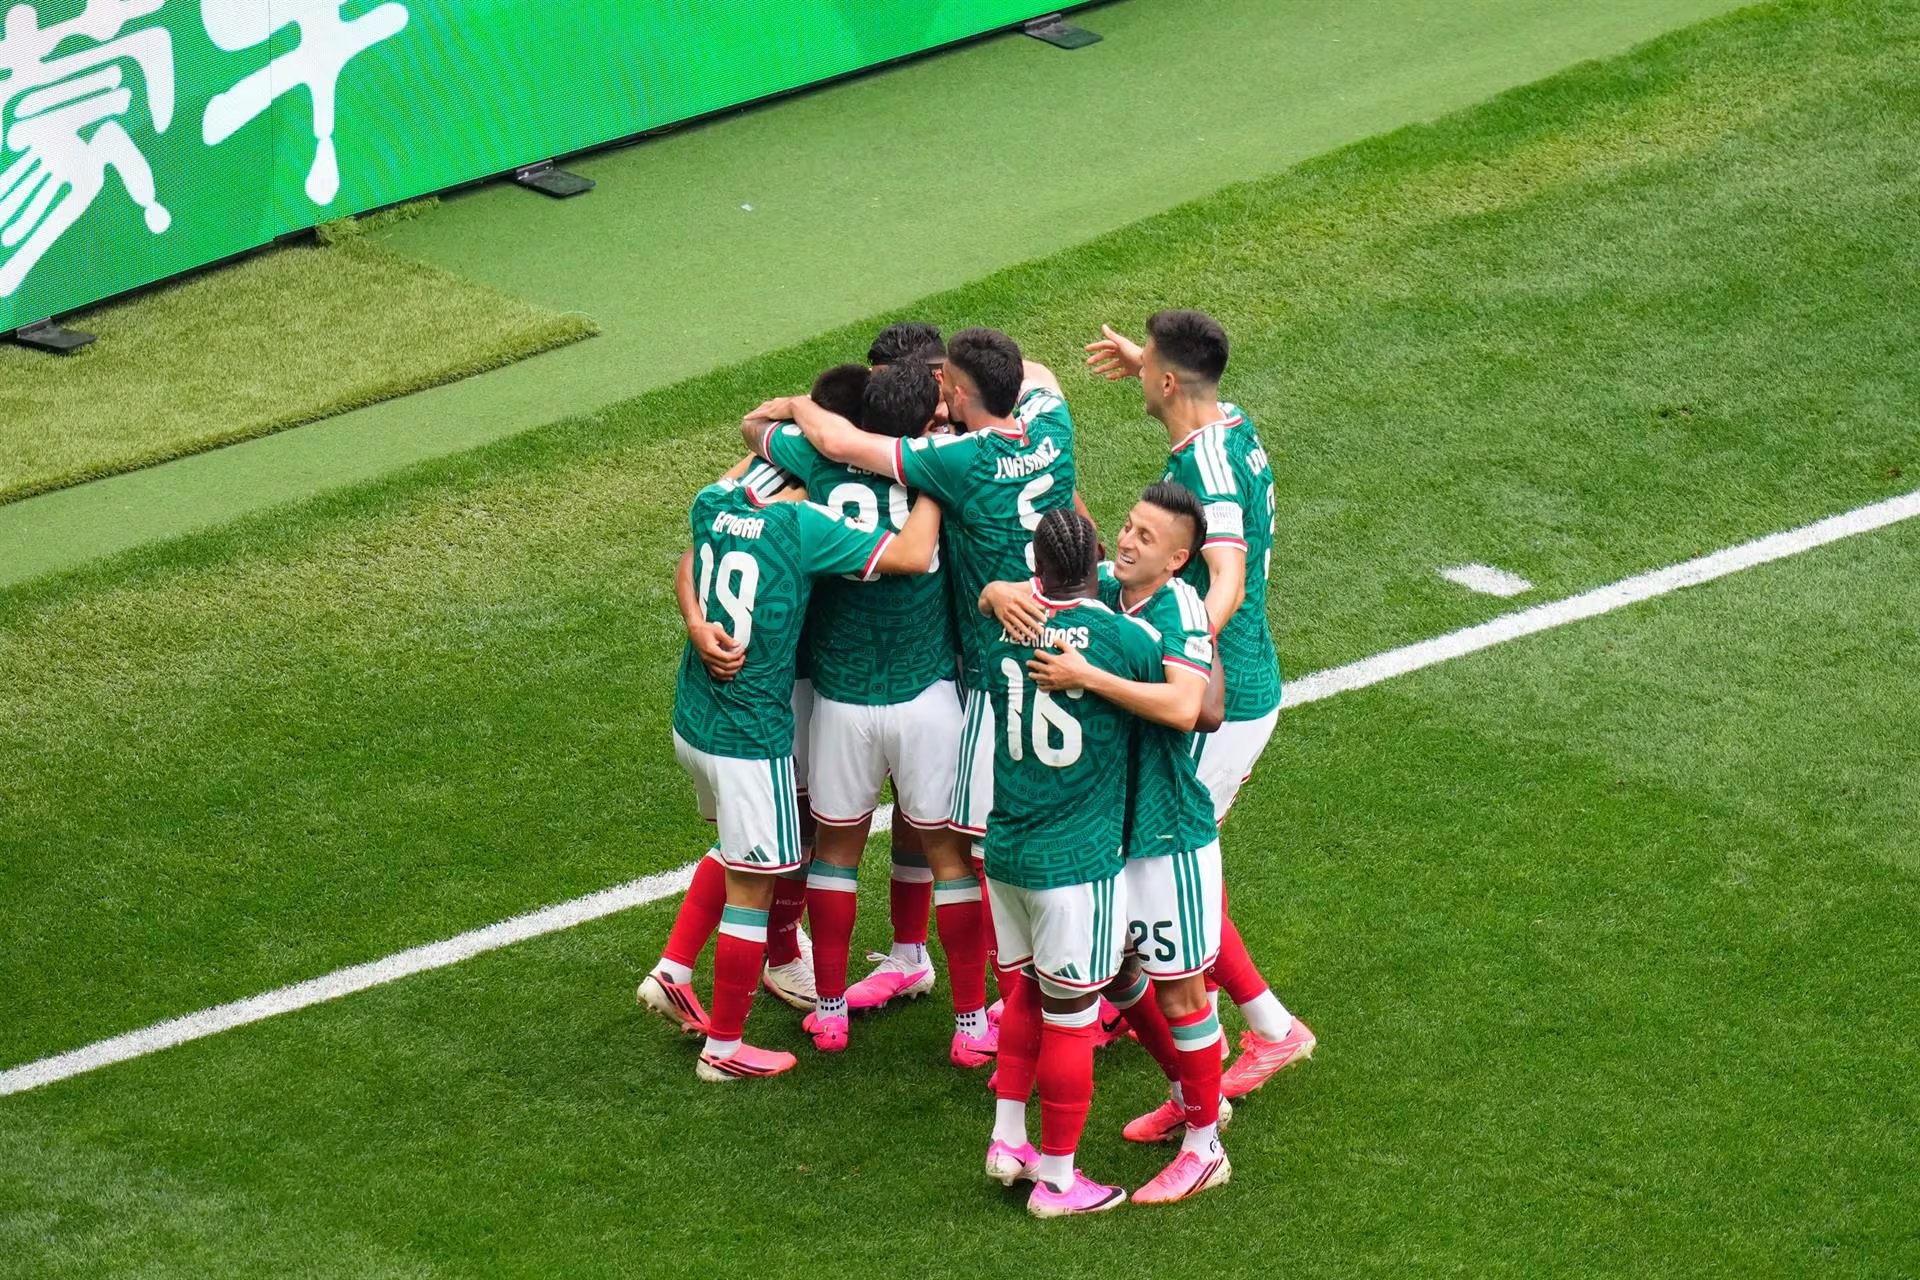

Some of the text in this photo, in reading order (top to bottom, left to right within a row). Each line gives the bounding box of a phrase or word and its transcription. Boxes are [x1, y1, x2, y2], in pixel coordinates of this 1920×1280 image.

[699, 543, 759, 653] 19
[1001, 657, 1084, 767] 16
[1129, 920, 1176, 962] 25
